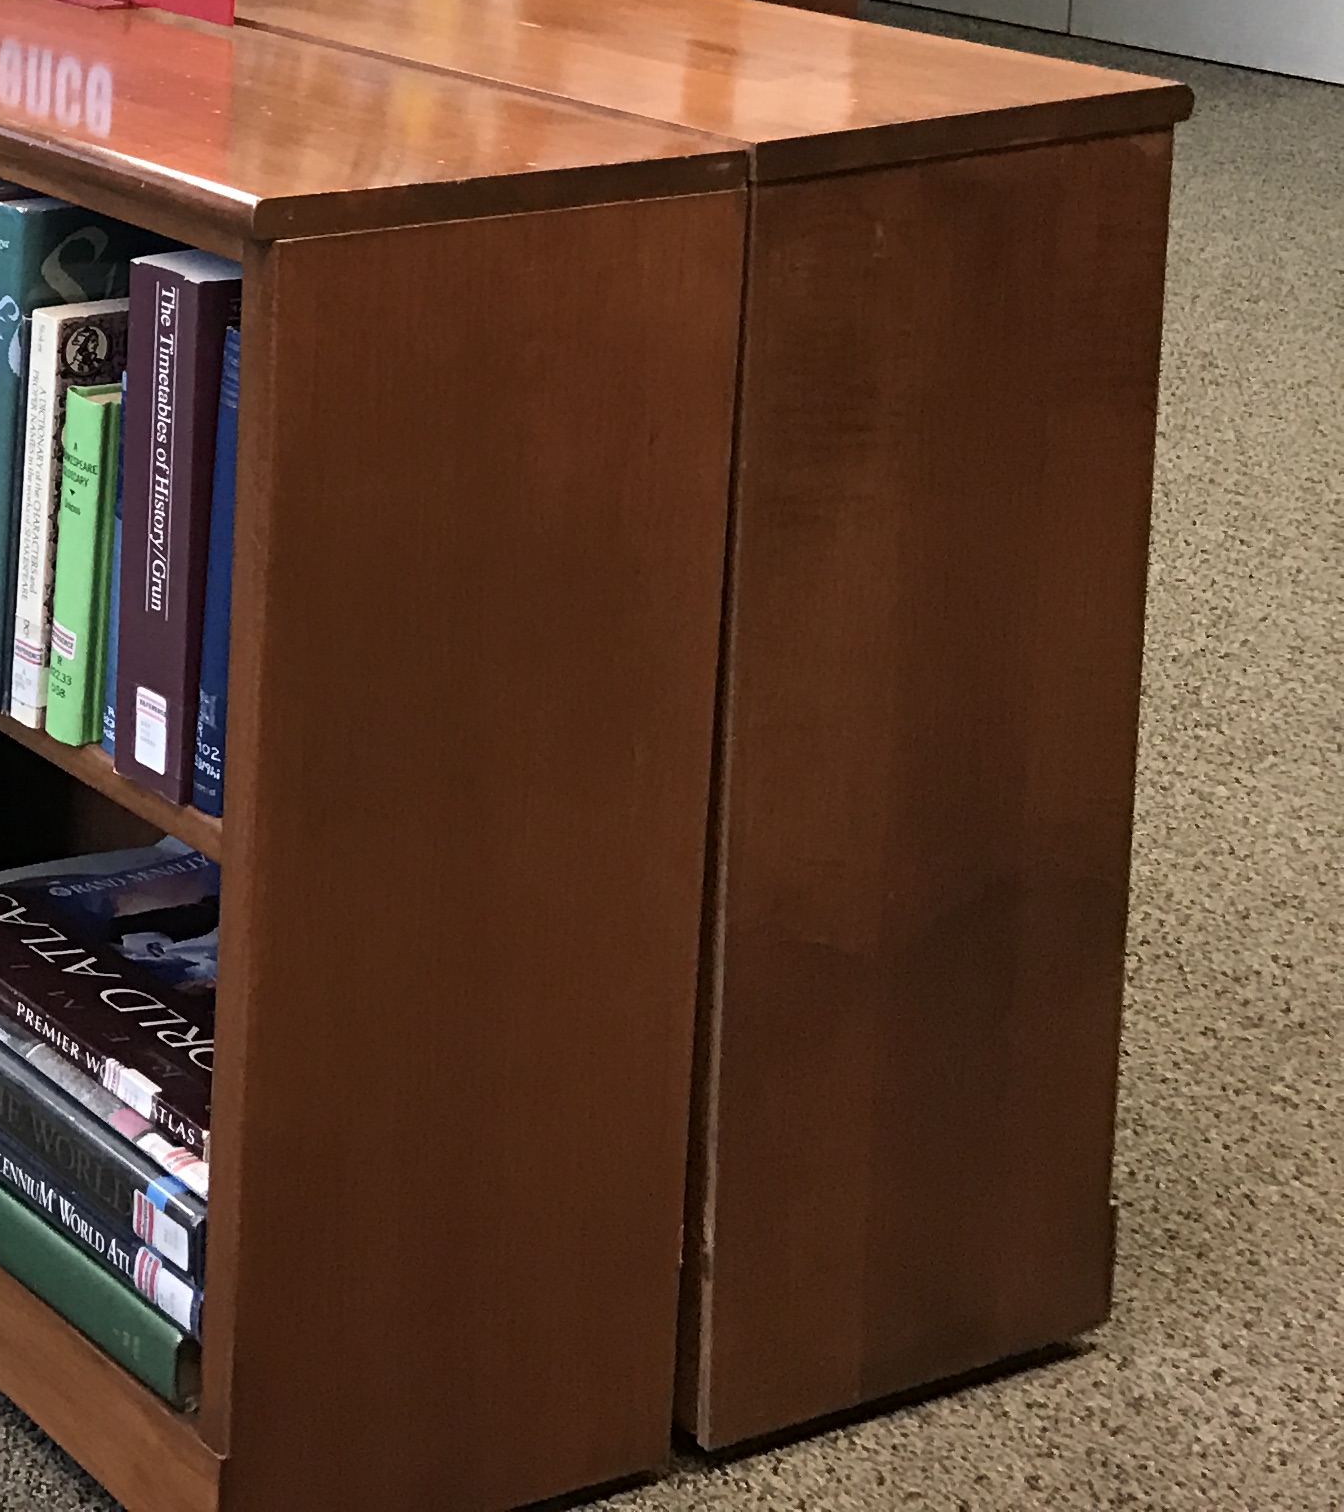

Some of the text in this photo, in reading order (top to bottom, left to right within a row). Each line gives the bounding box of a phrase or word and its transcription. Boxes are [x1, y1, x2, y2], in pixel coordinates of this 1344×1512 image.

[30, 369, 40, 410] PROPER
[28, 414, 38, 454] NAMES
[35, 398, 46, 468] DICTIONARY
[150, 286, 176, 611] The Timetables of History/Grun
[20, 526, 32, 600] SHAKESPEARE
[29, 500, 42, 574] CHARACTERS
[29, 575, 38, 594] and
[16, 1001, 81, 1058] PREMIER
